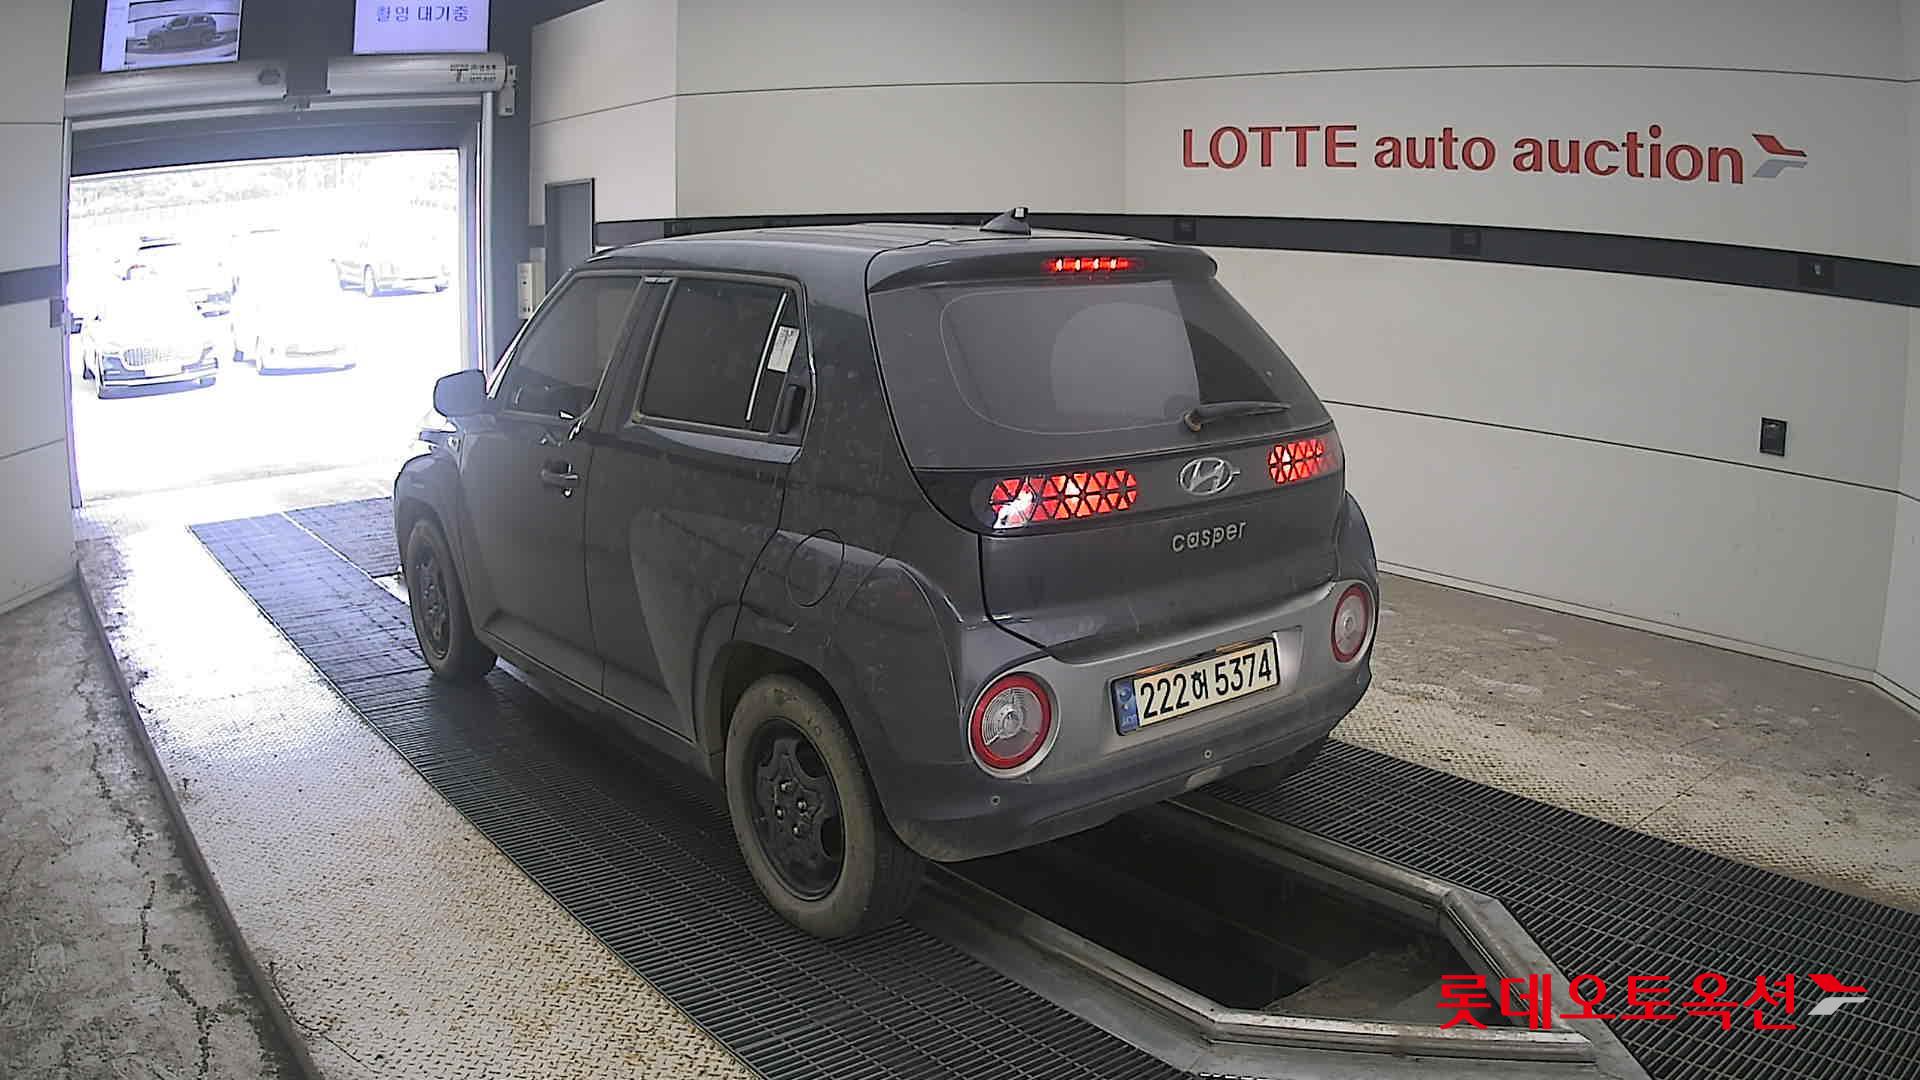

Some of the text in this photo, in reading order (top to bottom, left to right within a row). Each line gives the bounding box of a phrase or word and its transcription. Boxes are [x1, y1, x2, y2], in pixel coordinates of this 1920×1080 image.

[417, 4, 469, 22] 대기중
[1183, 124, 1744, 184] LOTTE auto auction
[1172, 521, 1247, 552] casper
[1215, 649, 1272, 696] 5374
